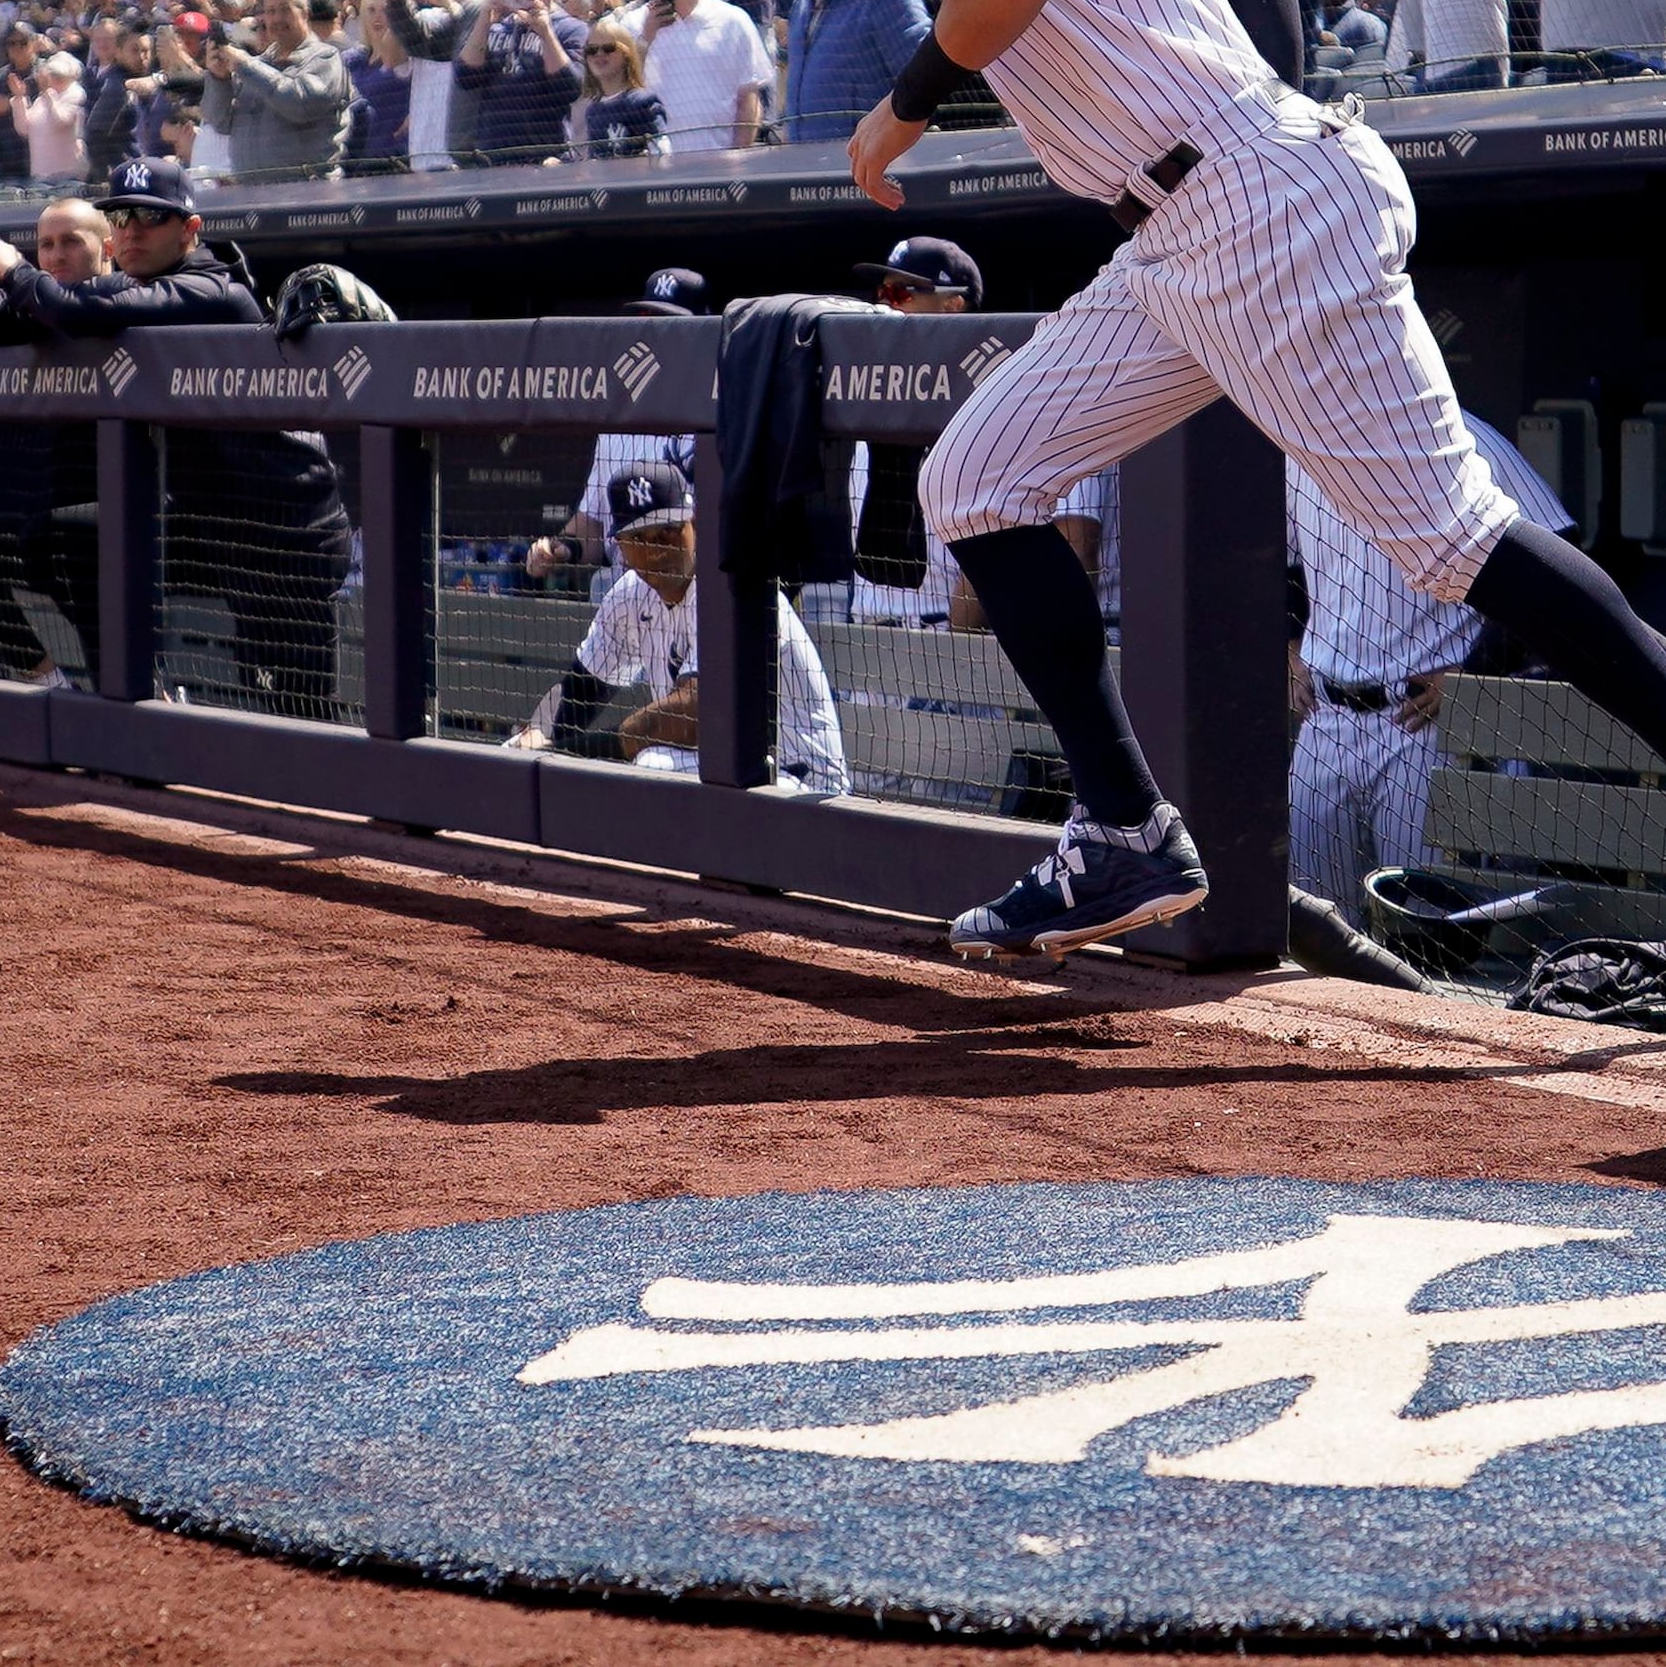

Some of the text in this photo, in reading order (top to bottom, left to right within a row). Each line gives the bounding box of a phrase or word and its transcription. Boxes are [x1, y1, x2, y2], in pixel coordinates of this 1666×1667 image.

[1393, 140, 1446, 159] MERICA
[1545, 131, 1586, 151] BANK
[1590, 130, 1609, 149] OF
[790, 185, 872, 201] BANK OF AMERI
[949, 172, 1049, 195] BANK OF AMERICA
[516, 196, 590, 215] BANK OF AMERICA
[646, 187, 728, 204] BANK OF AMERICA
[288, 212, 350, 227] BANK OF AMERICA
[397, 205, 464, 222] BANK OF AMERICA
[11, 368, 28, 394] OF
[34, 367, 98, 394] AMERICA
[170, 366, 328, 397] BANK OF AMERICA
[413, 366, 608, 400] BANK OF AMERICA
[826, 364, 951, 401] AMERICA
